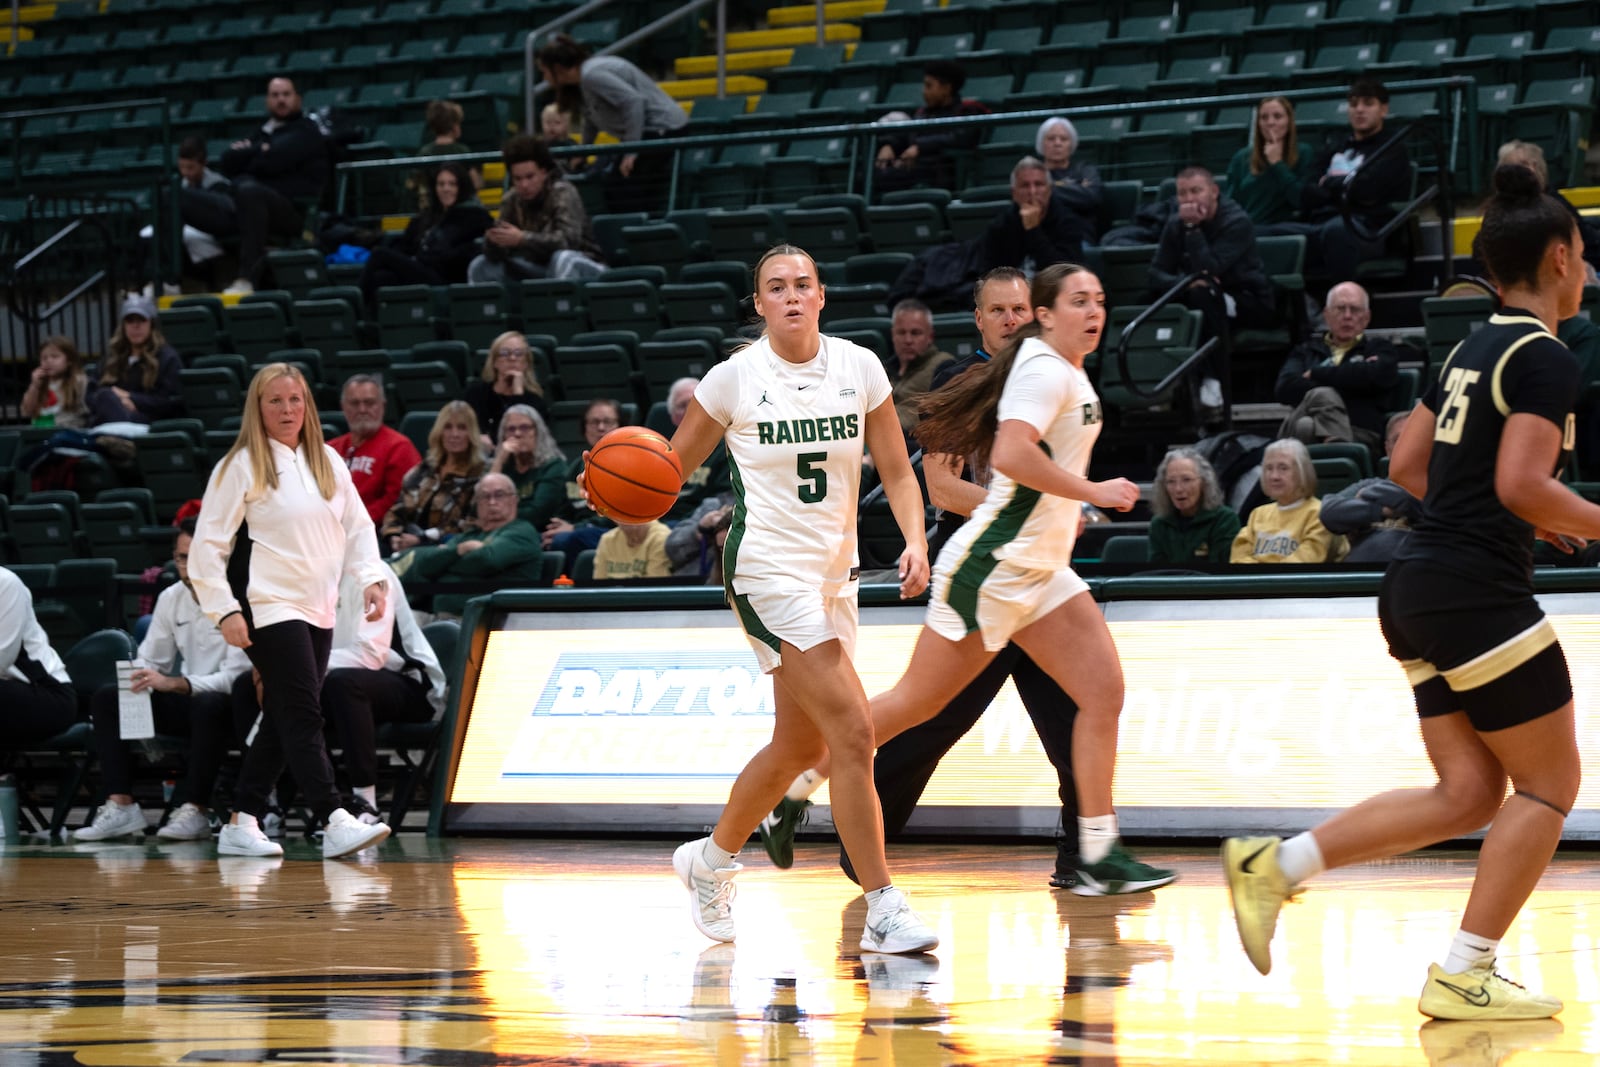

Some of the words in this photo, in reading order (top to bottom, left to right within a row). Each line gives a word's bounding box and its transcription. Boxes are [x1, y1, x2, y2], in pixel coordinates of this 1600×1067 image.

[757, 413, 859, 445] RAIDERS
[1434, 367, 1482, 445] 25
[797, 451, 828, 504] 5
